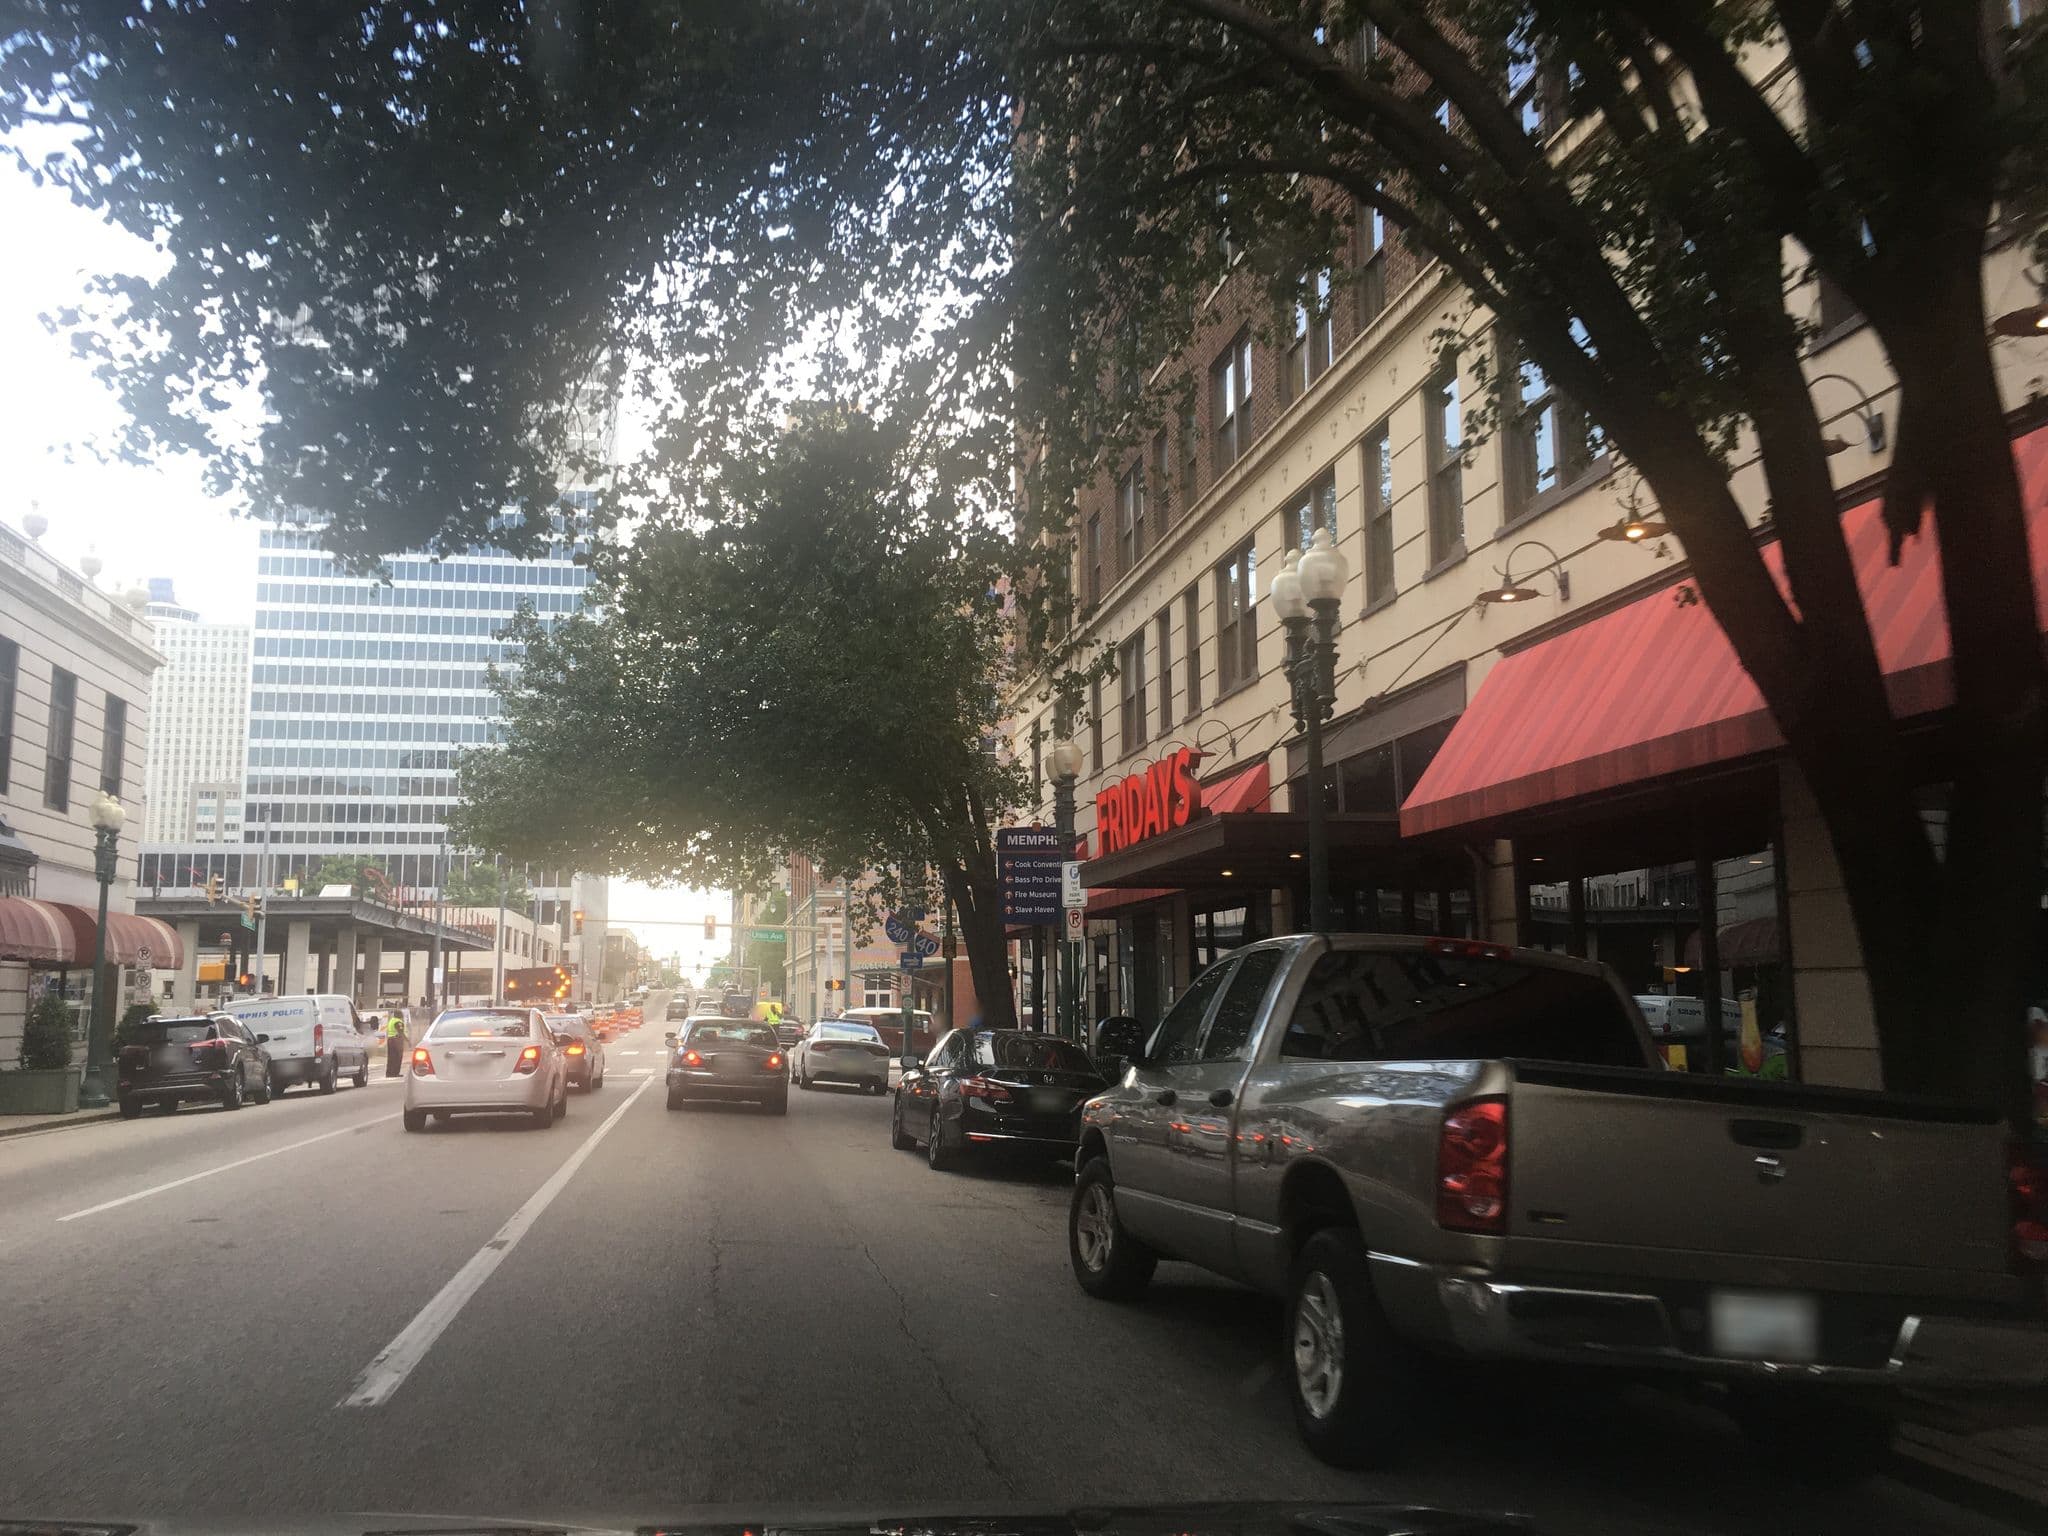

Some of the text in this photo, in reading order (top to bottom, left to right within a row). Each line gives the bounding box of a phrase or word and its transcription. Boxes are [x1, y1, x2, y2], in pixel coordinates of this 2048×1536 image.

[1096, 747, 1192, 859] FRIDAYS
[1014, 860, 1031, 868] Cook
[1015, 906, 1033, 914] Slave
[887, 922, 909, 942] 240
[916, 938, 937, 955] 40
[272, 1008, 304, 1017] POLICE
